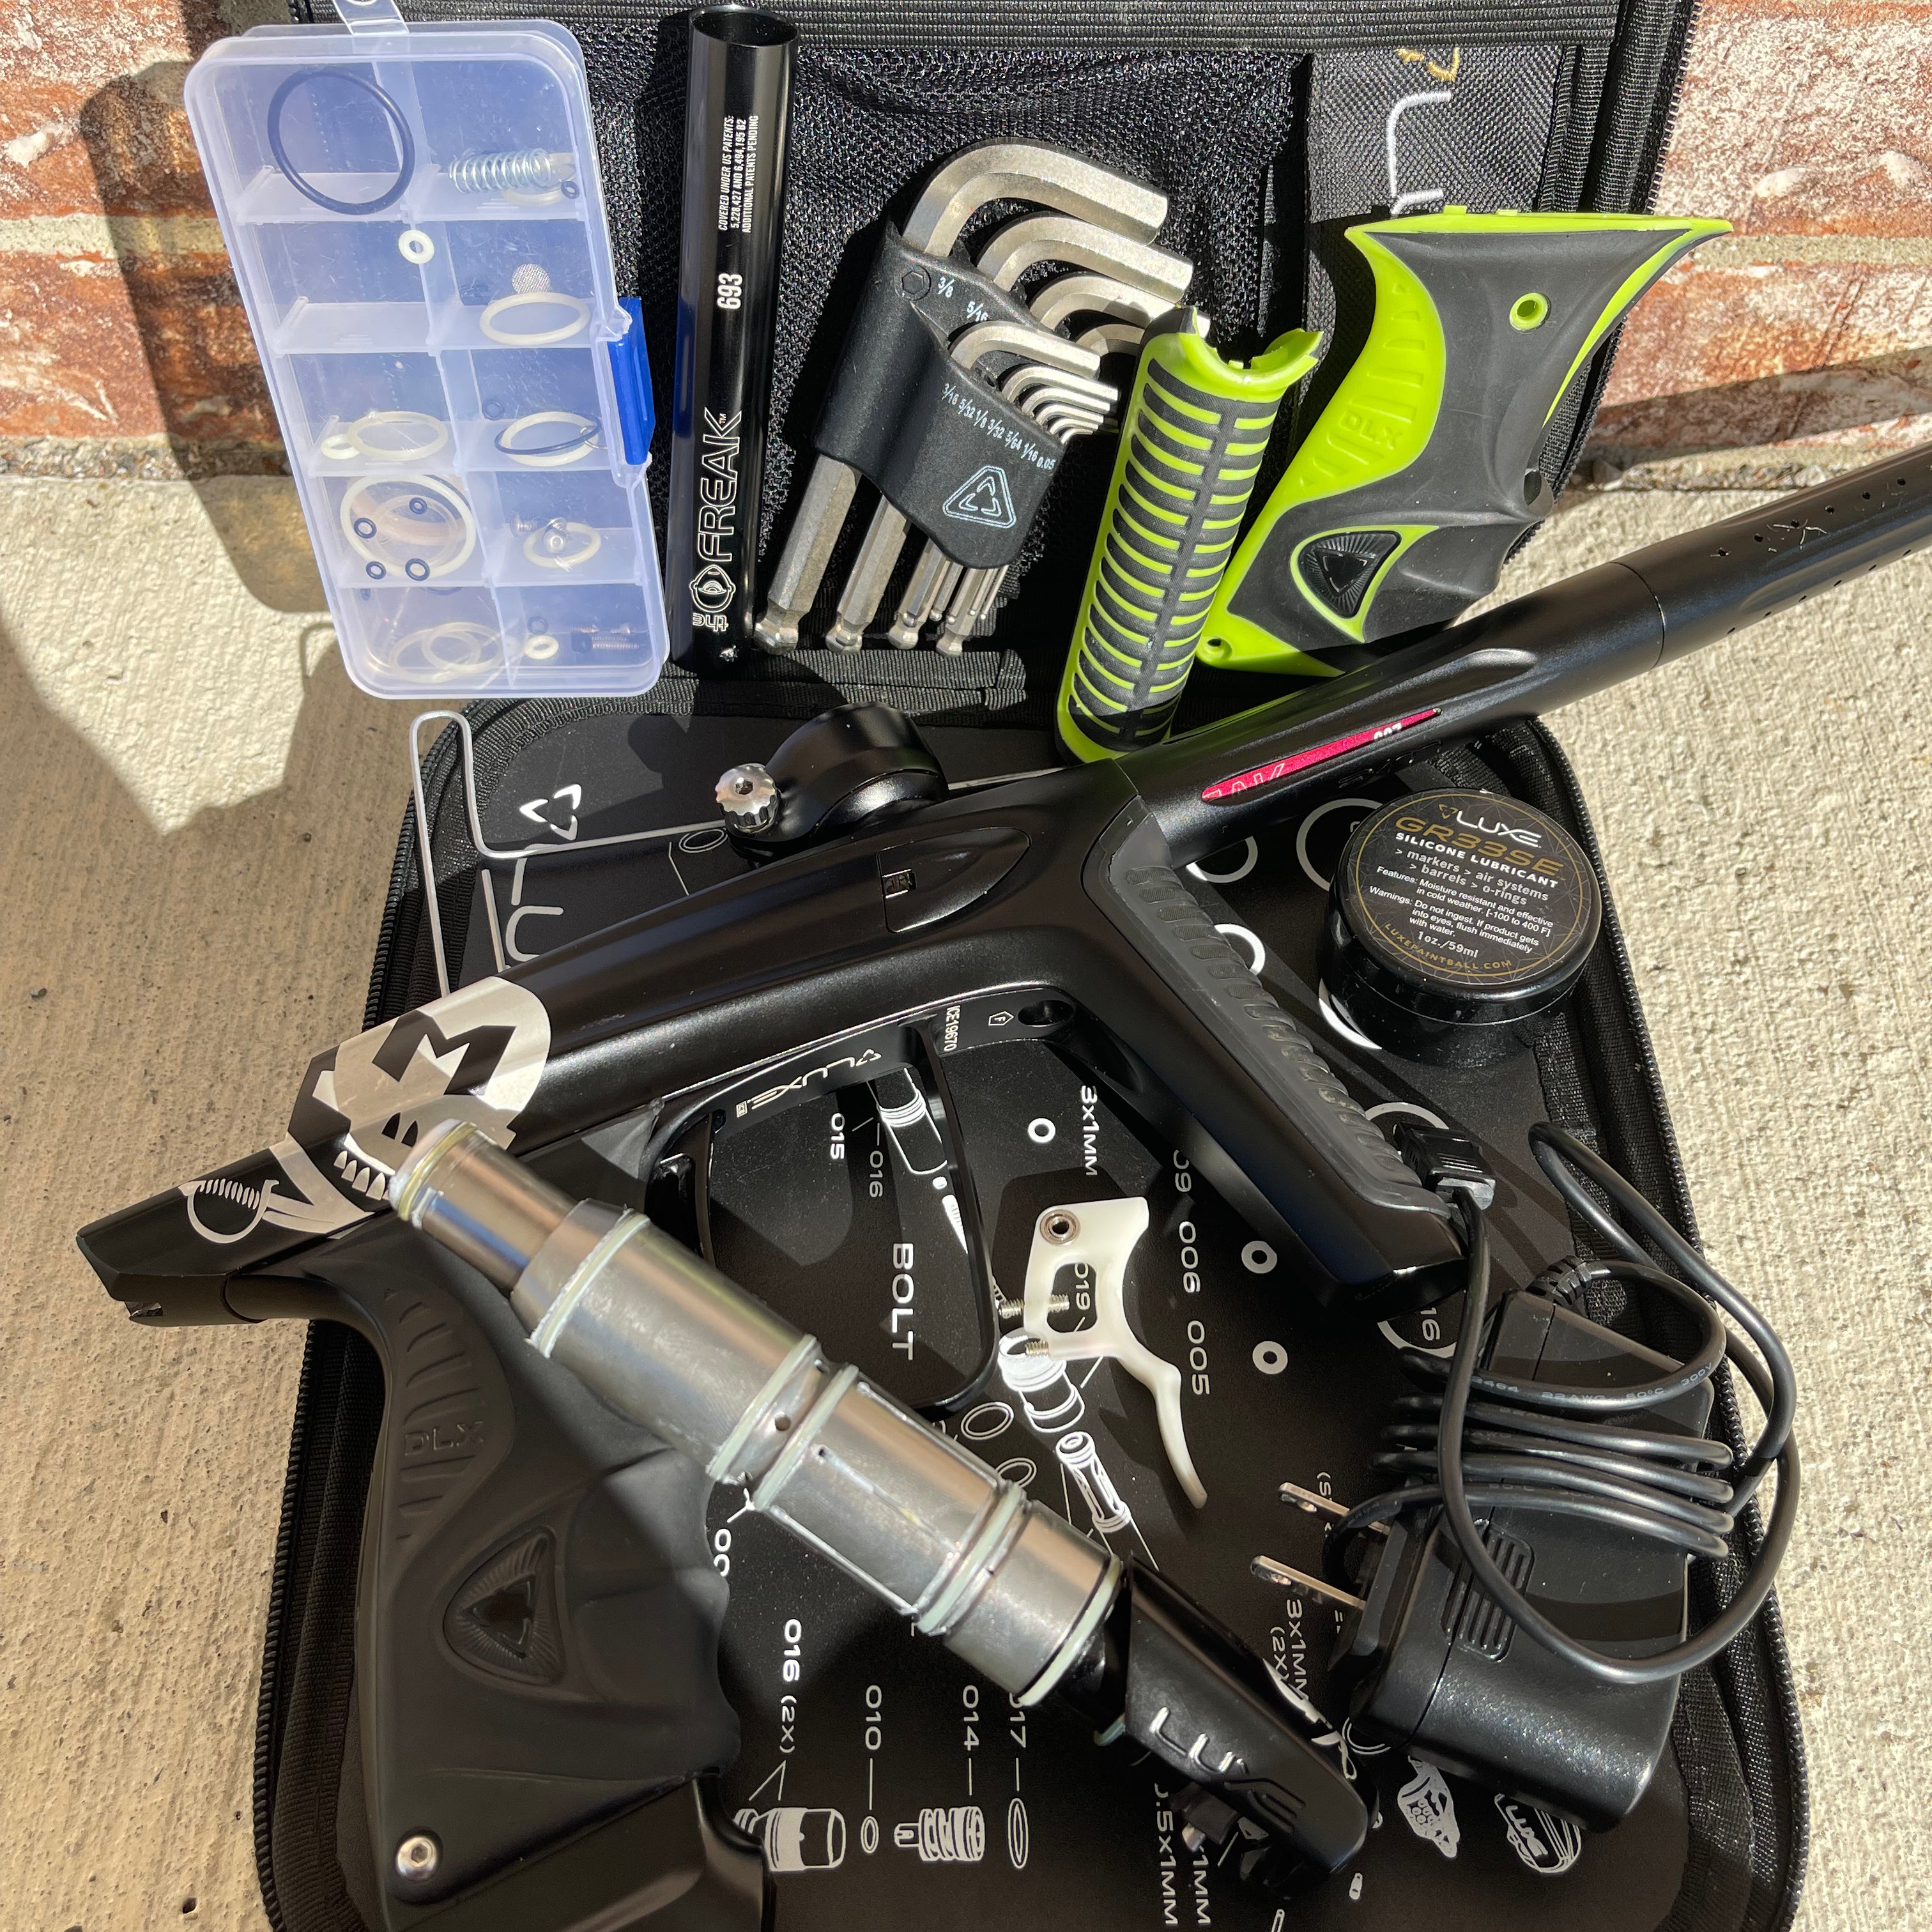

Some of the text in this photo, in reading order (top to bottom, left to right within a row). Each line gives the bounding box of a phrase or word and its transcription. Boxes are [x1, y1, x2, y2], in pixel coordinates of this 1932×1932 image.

[718, 115, 734, 231] COVERED UNDER US PATENTS:
[733, 172, 743, 189] AND
[742, 115, 759, 233] ADDITIONAL PATENTS PENDING
[730, 190, 742, 229] 5,228,427
[717, 273, 743, 310] 693
[938, 277, 954, 298] 3/8
[966, 300, 988, 322] 5/16
[941, 383, 960, 406] 3/16
[958, 398, 976, 420] 5/32
[975, 410, 989, 429] 1/8
[987, 418, 1006, 439] 3/32
[1004, 431, 1023, 450] 5/64
[1021, 443, 1038, 463] 1/16
[1339, 409, 1404, 451] DLX
[1457, 810, 1542, 848] LUXE
[1395, 832, 1559, 888] SILICONE LUBRICANT
[1407, 850, 1460, 873] markers
[1475, 871, 1494, 882] air
[1496, 878, 1549, 901] systems
[1376, 866, 1554, 928] Features: Moisture resistant and effective
[1421, 864, 1467, 885] barrels
[1482, 885, 1527, 905] o-rings
[1369, 885, 1539, 946] Warnings: Do not ingest. If product gets
[1409, 917, 1456, 937] with water.
[1411, 908, 1429, 919] into
[1456, 922, 1478, 935] flush
[1479, 929, 1533, 954] immediately
[1416, 886, 1425, 895] in
[1427, 891, 1446, 901] cold
[1447, 897, 1484, 914] weather.
[1511, 917, 1521, 925] to
[1521, 921, 1540, 931] 400
[1540, 926, 1551, 937] F]
[1385, 923, 1512, 969] LUXEPAINTBALL.COM
[944, 1004, 961, 1052] ICE19670
[830, 1112, 845, 1160] 015
[869, 1150, 883, 1198] 016
[1173, 1149, 1192, 1192] 09
[1179, 1221, 1200, 1293] 006
[892, 1243, 914, 1361] BOLT
[1075, 1262, 1091, 1310] 019
[1420, 1307, 1441, 1341] 16
[1187, 1320, 1210, 1395] 005
[404, 1420, 484, 1457] DLX
[714, 1528, 732, 1577] 00
[783, 1618, 802, 1682] 016
[865, 1685, 882, 1751] 010
[963, 1685, 979, 1751] 014
